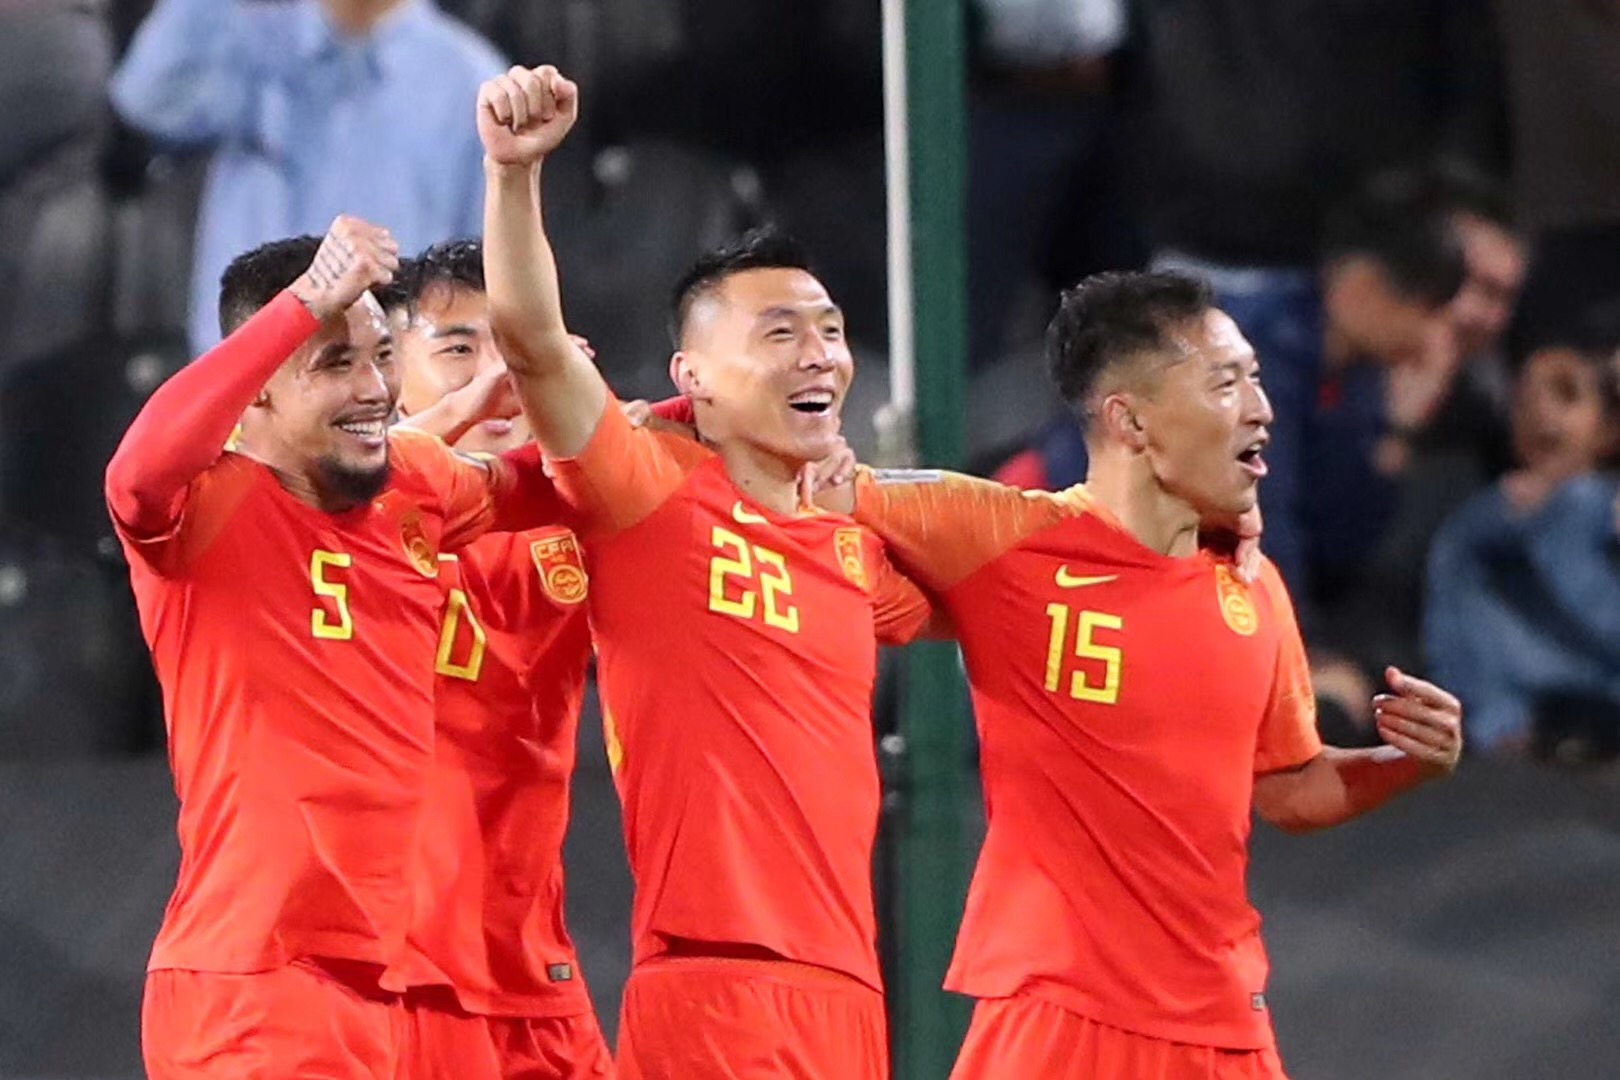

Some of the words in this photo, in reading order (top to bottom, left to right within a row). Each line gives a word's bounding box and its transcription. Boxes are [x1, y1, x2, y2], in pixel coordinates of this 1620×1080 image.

[311, 549, 353, 640] 5
[709, 526, 799, 634] 22
[1045, 603, 1124, 705] 15
